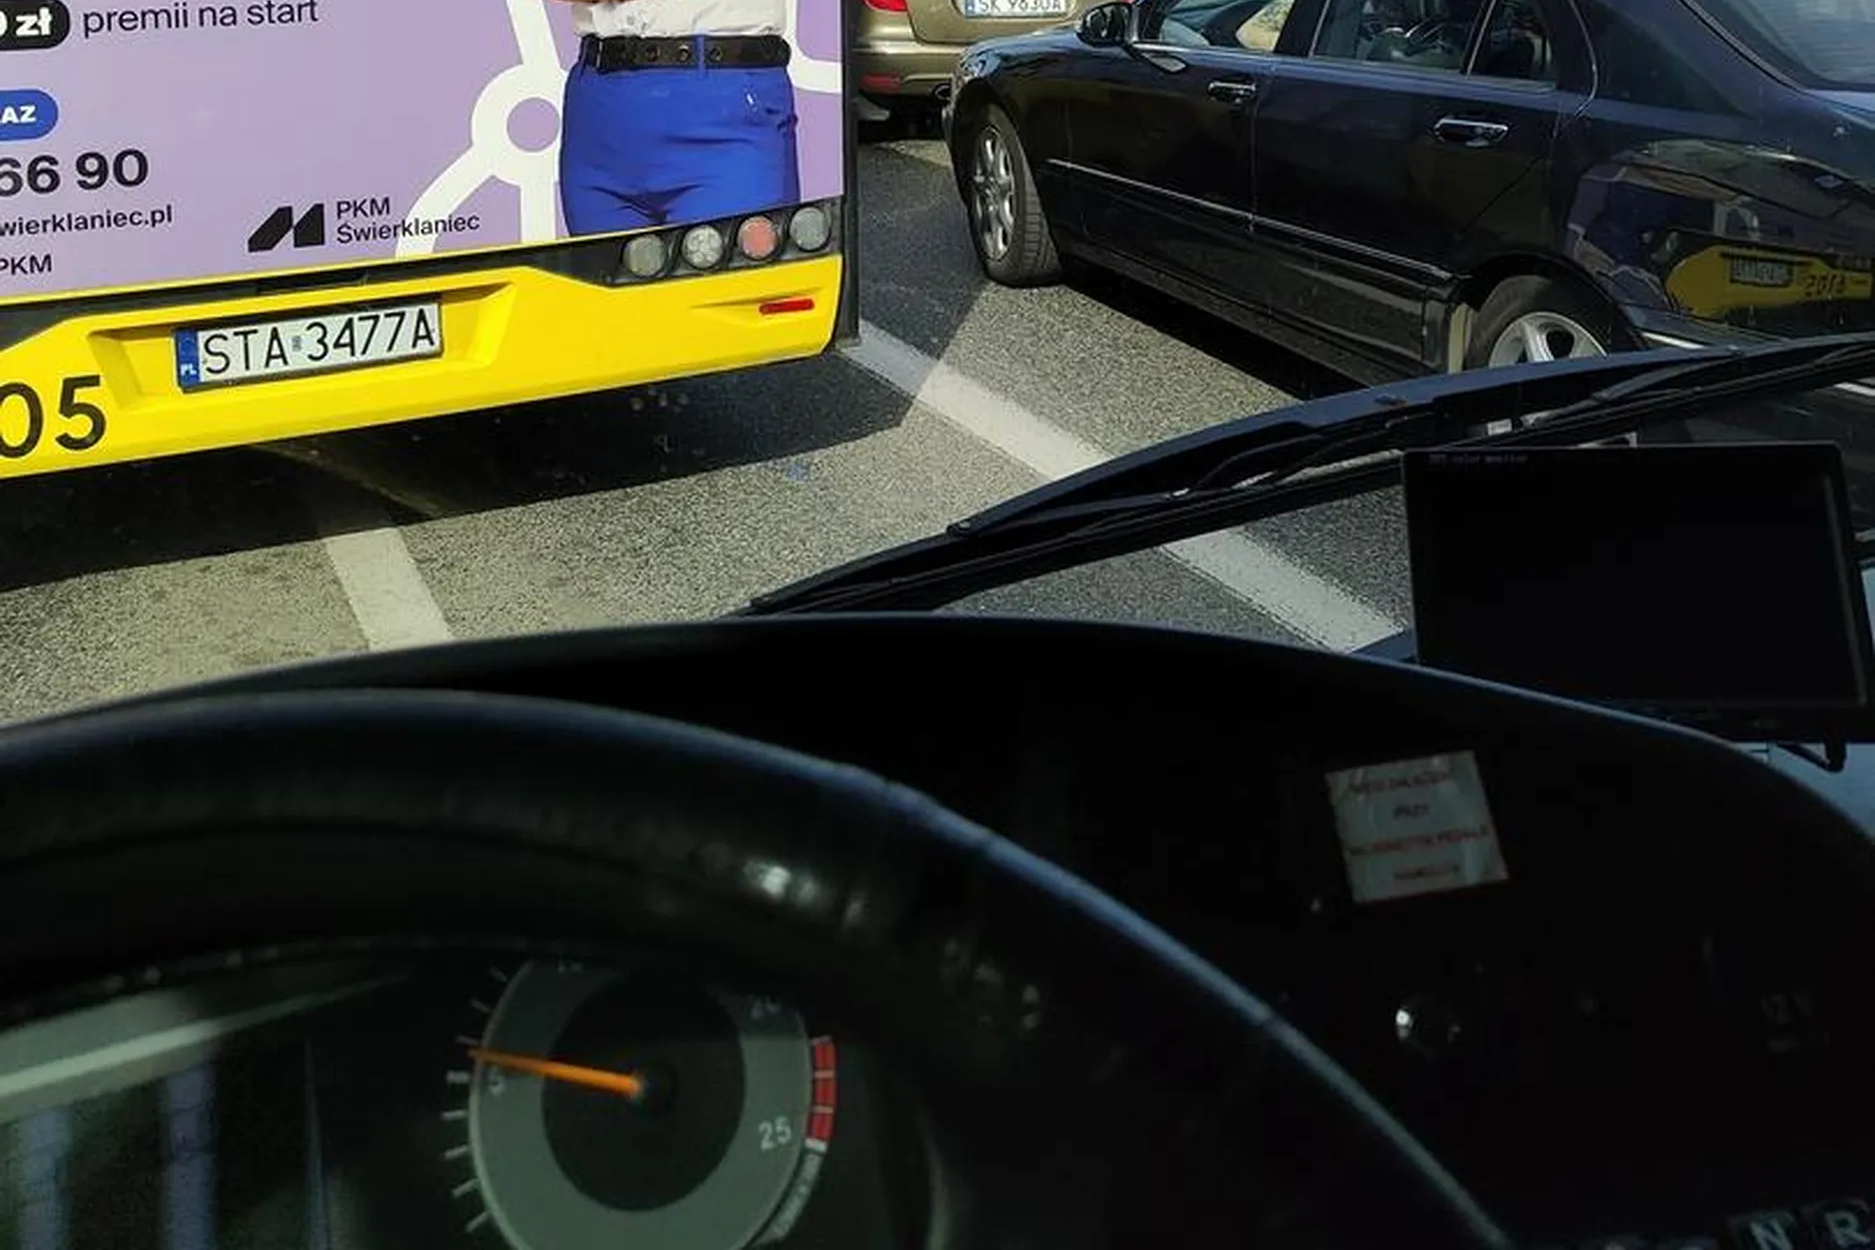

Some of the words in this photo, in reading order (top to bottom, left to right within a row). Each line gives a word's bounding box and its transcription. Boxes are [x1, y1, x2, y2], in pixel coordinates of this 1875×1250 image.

[15, 6, 52, 37] zł
[83, 1, 190, 39] premii
[199, 4, 238, 27] na
[75, 148, 149, 191] 90
[335, 196, 391, 221] PKM
[336, 213, 481, 244] Świerklaniec
[203, 325, 290, 376] STA
[305, 307, 436, 362] 3477A
[758, 1116, 793, 1150] 25
[1824, 1209, 1872, 1250] R
